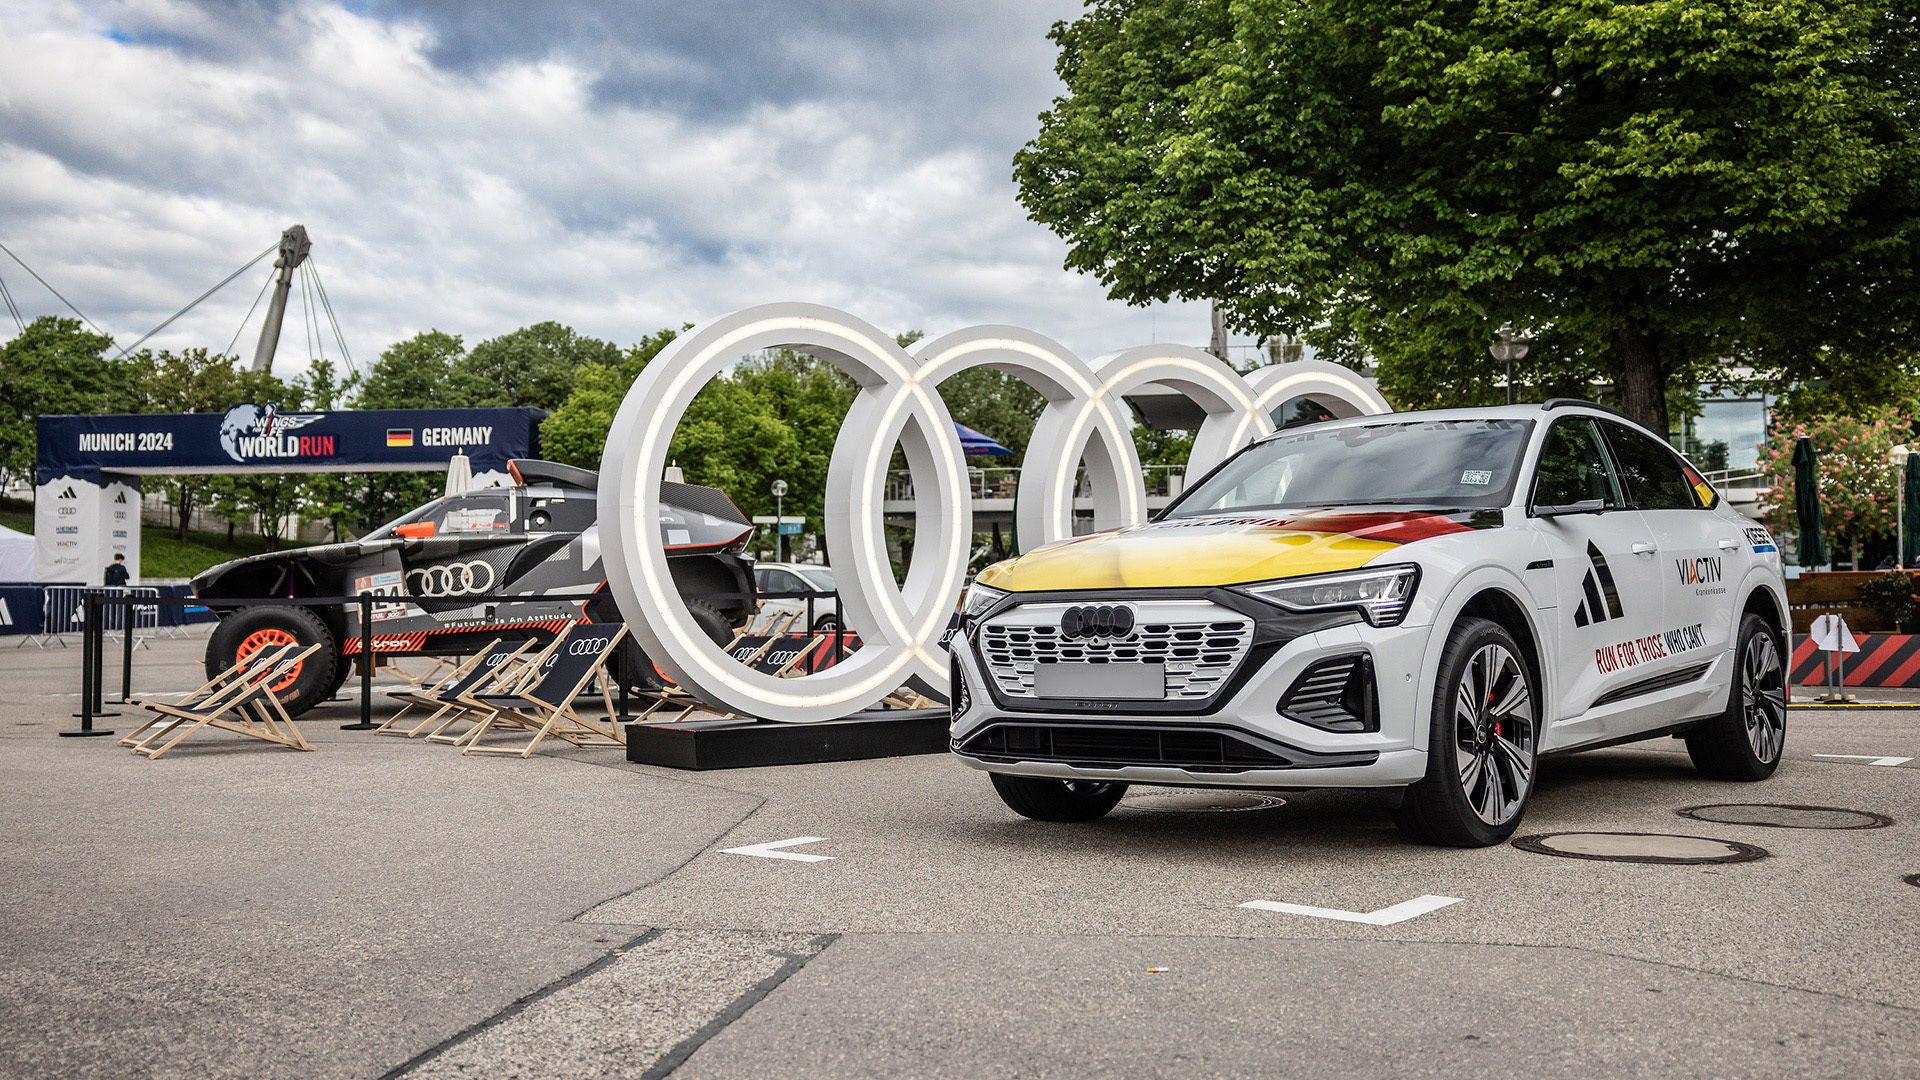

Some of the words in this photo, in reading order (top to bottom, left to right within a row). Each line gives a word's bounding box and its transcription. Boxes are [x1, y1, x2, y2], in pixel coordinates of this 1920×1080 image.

[255, 416, 297, 427] WINGS
[79, 433, 135, 451] MUNICH
[138, 432, 174, 451] 2024
[422, 426, 493, 446] GERMANY
[1742, 527, 1770, 545] KIESE
[1676, 556, 1721, 585] VIACTIV
[444, 620, 486, 629] #Future
[527, 612, 572, 622] Attitude
[357, 640, 410, 648] tron
[1595, 645, 1619, 674] RUN
[1616, 641, 1639, 668] FOR
[1636, 633, 1667, 662] THOSE
[1663, 629, 1686, 655] WHO
